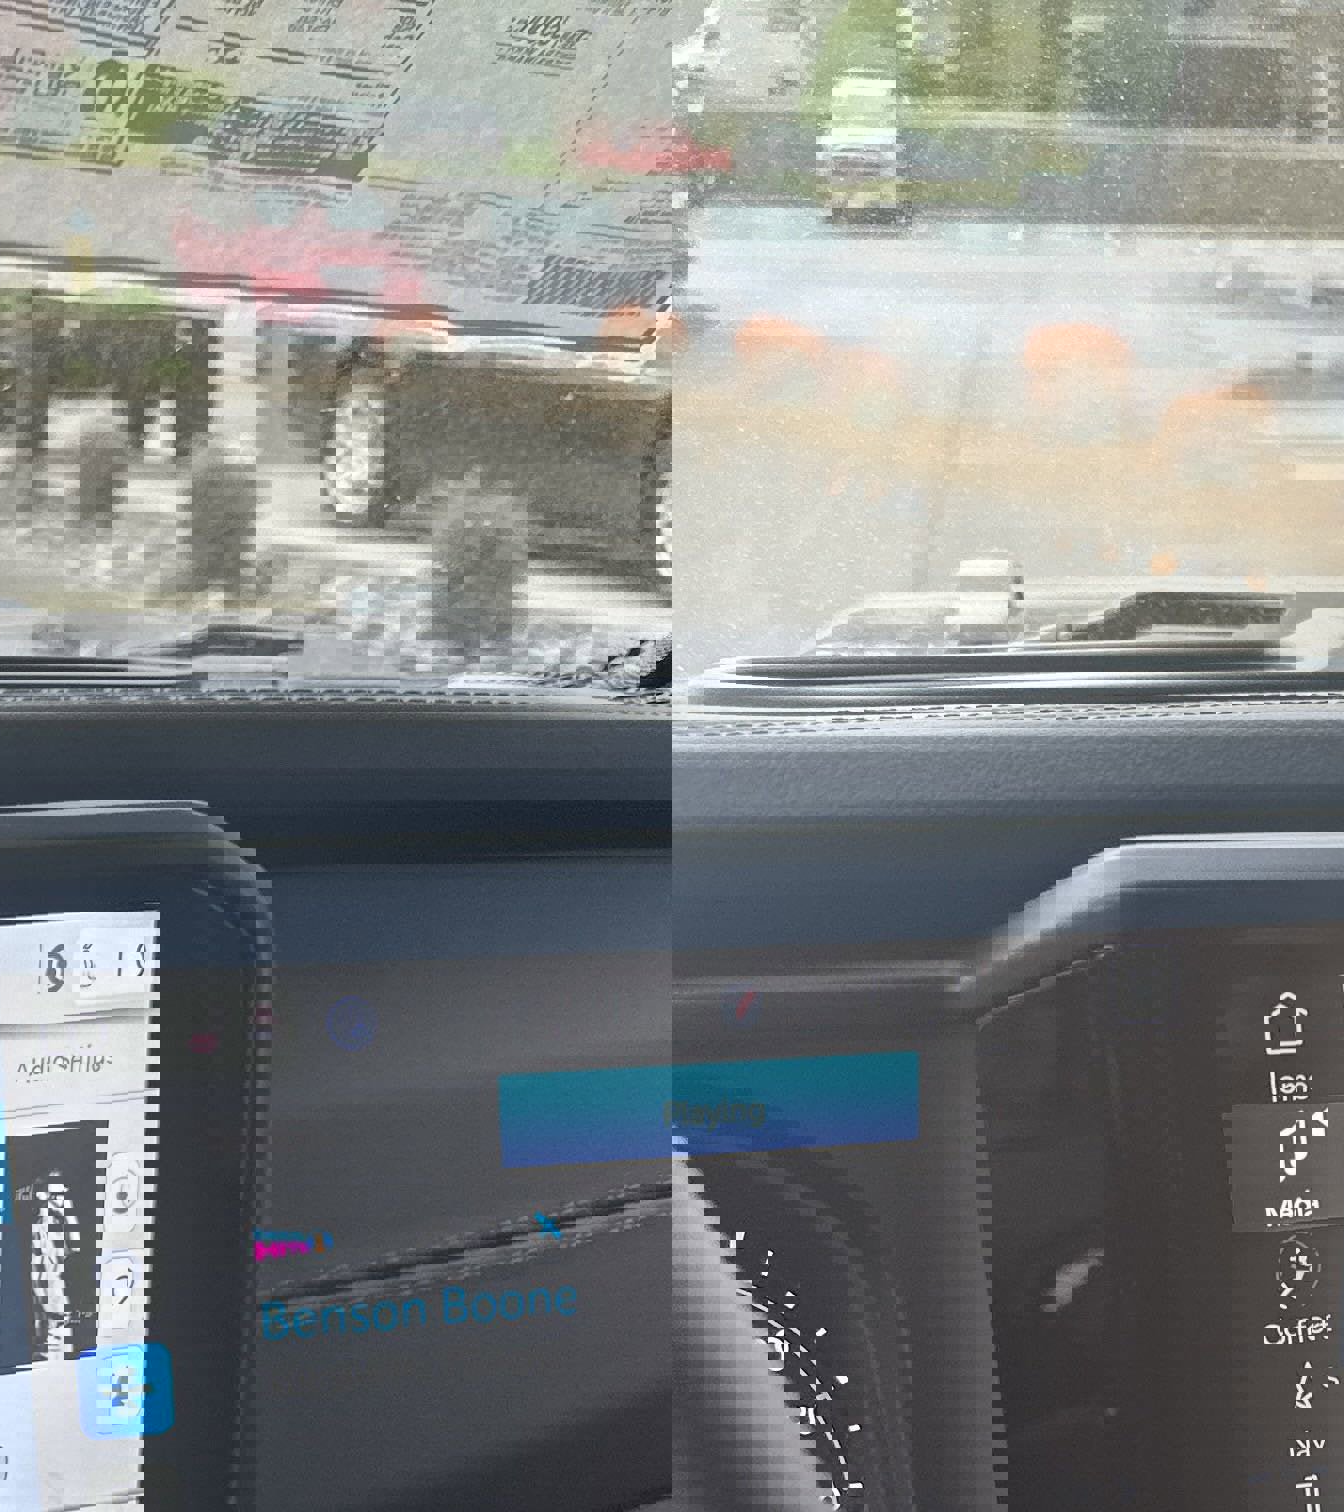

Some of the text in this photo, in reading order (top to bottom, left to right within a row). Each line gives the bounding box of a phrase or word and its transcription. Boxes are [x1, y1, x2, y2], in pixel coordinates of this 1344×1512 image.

[863, 962, 981, 1007] 10:40
[539, 1021, 588, 1044] OUT
[1067, 1072, 1158, 1101] Browse
[663, 1098, 766, 1131] Playing
[207, 1127, 333, 1155] Sources
[262, 1283, 578, 1340] Benson Boone
[264, 1345, 559, 1397] Beautiful Things
